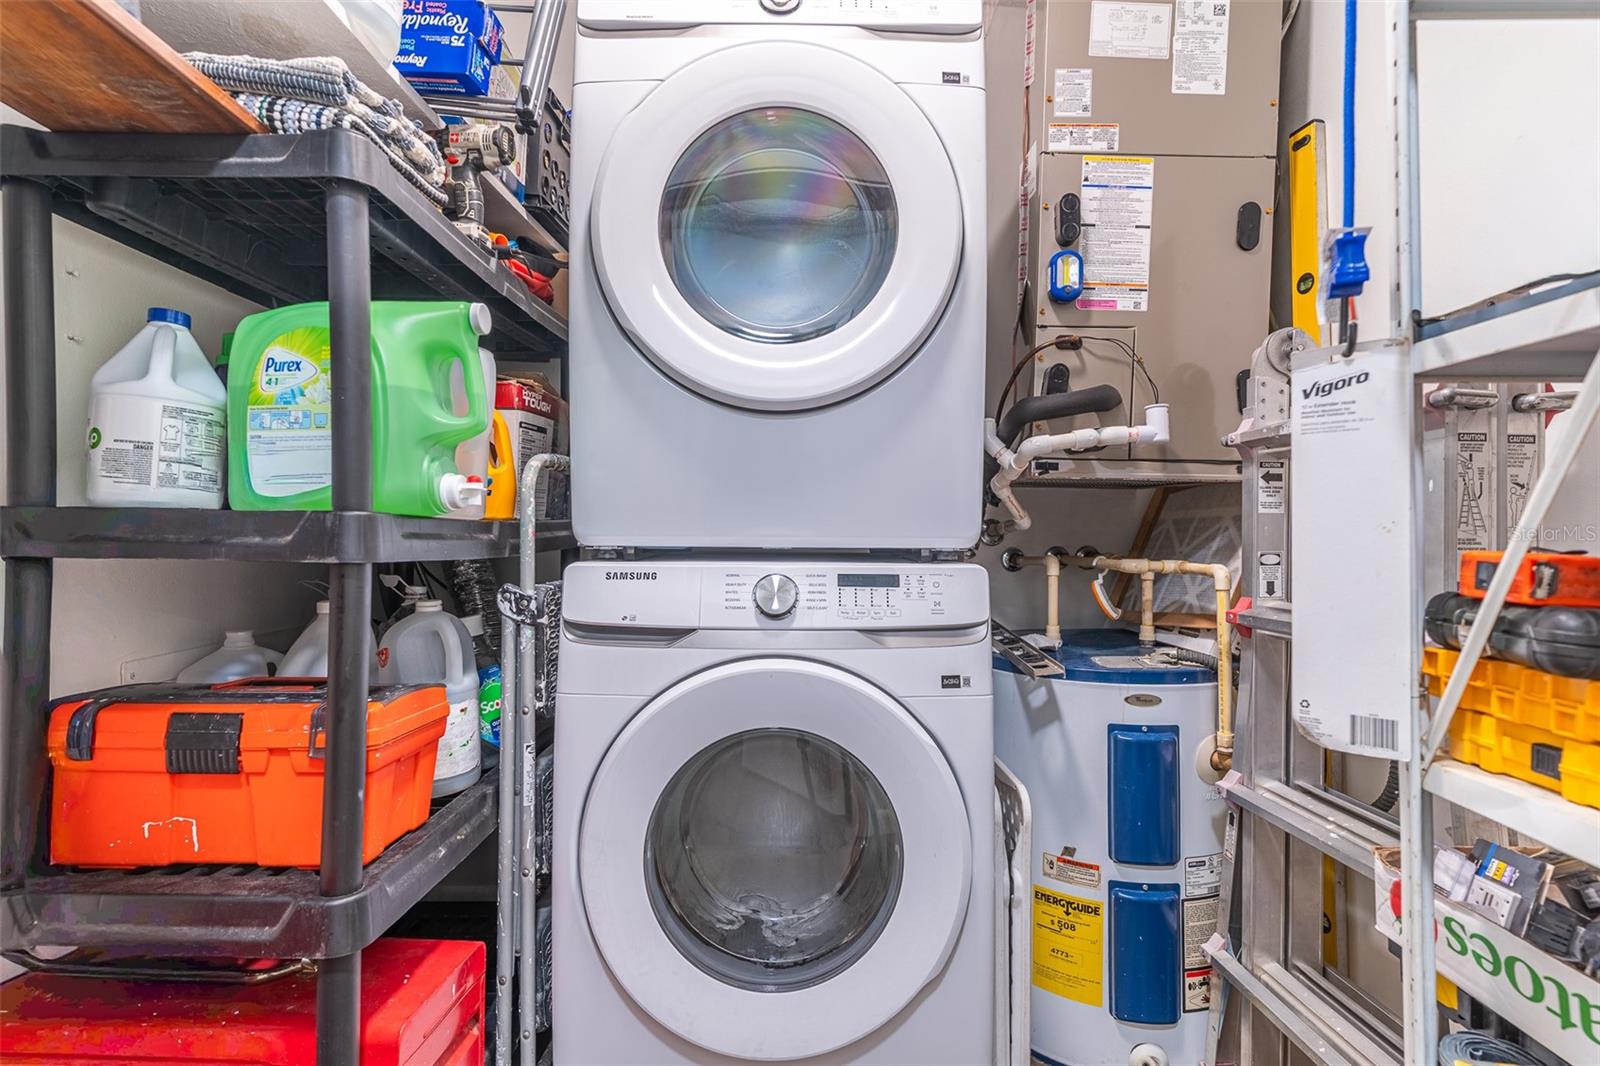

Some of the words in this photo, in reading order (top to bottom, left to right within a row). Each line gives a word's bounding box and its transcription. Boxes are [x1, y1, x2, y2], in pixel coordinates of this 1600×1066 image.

[450, 35, 466, 47] 75
[264, 357, 302, 373] Purex
[1301, 371, 1370, 400] Vigoro
[522, 389, 543, 400] HYPER
[522, 396, 552, 413] TOUGH
[132, 443, 154, 451] DANGER
[605, 571, 658, 581] SAMSUNG
[1034, 890, 1101, 917] ENERGYGUIDE
[1057, 919, 1076, 931] 508
[1050, 948, 1069, 958] 4773
